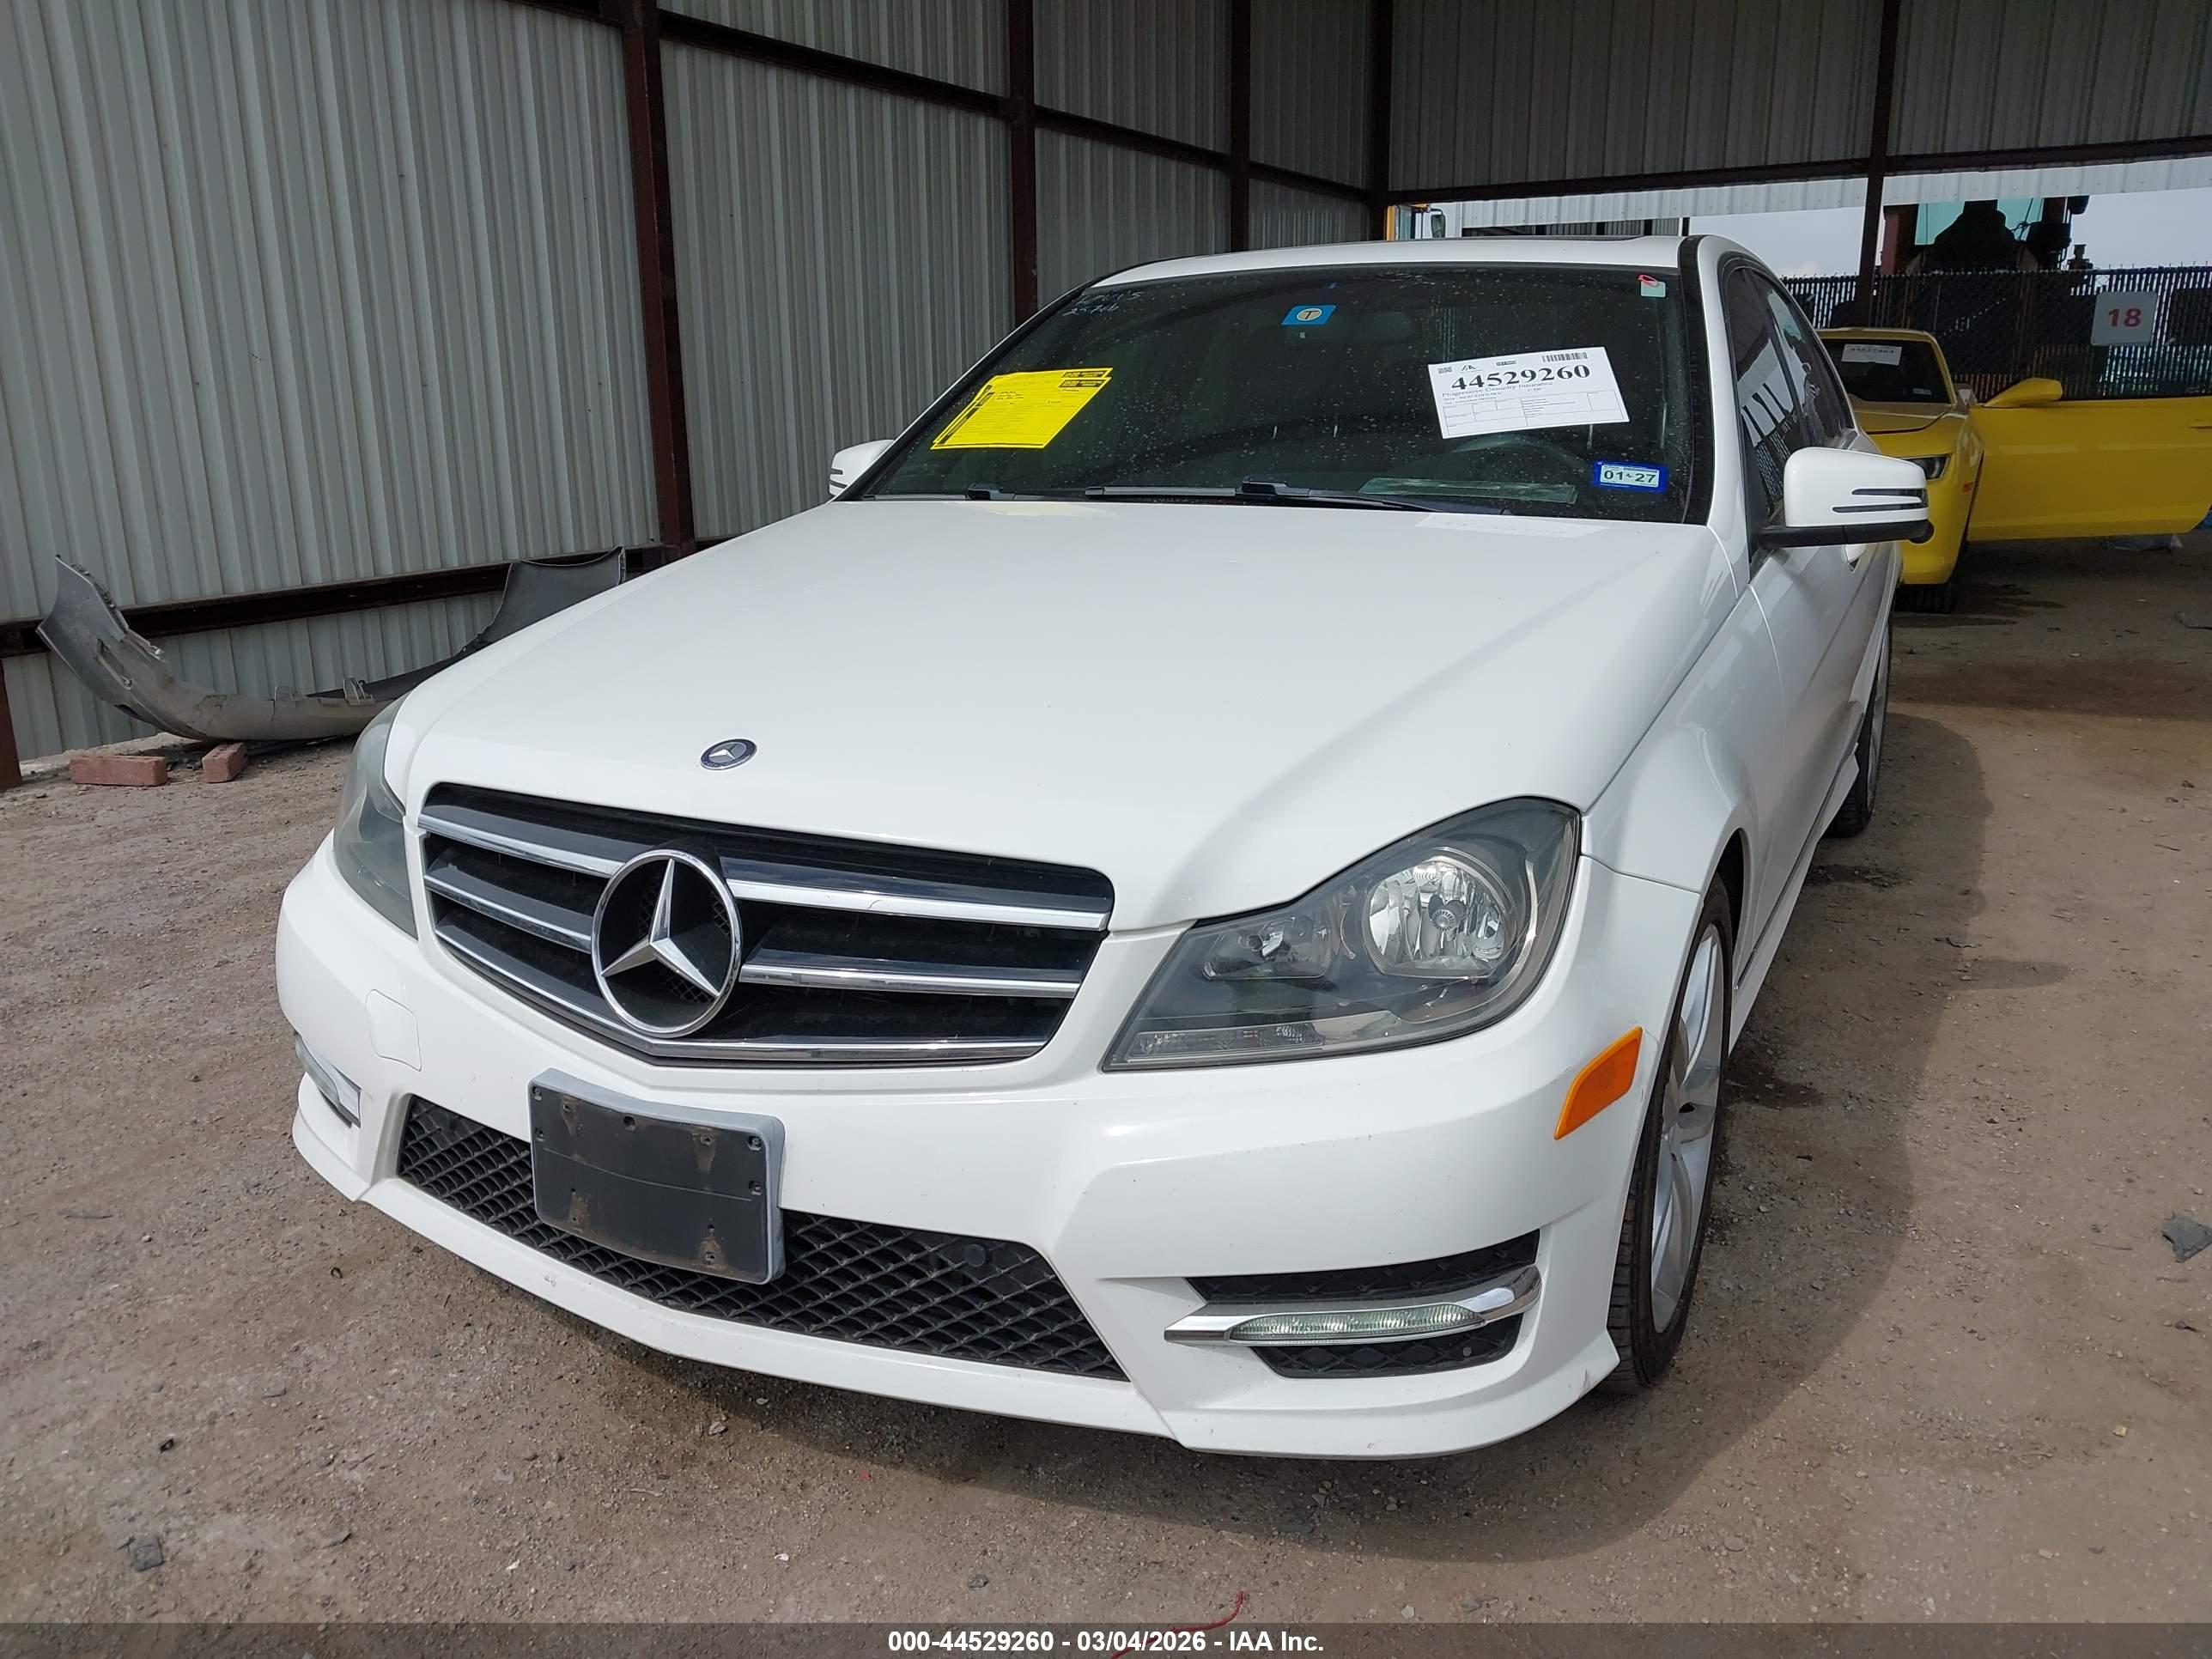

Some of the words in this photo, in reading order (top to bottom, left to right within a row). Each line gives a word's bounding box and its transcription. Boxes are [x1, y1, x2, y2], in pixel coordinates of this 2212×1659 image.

[2108, 307, 2142, 327] 18
[1451, 364, 1590, 390] 44529260
[1442, 389, 1484, 398] Progressive
[1485, 384, 1516, 392] Casualty
[1519, 380, 1553, 389] Insurance
